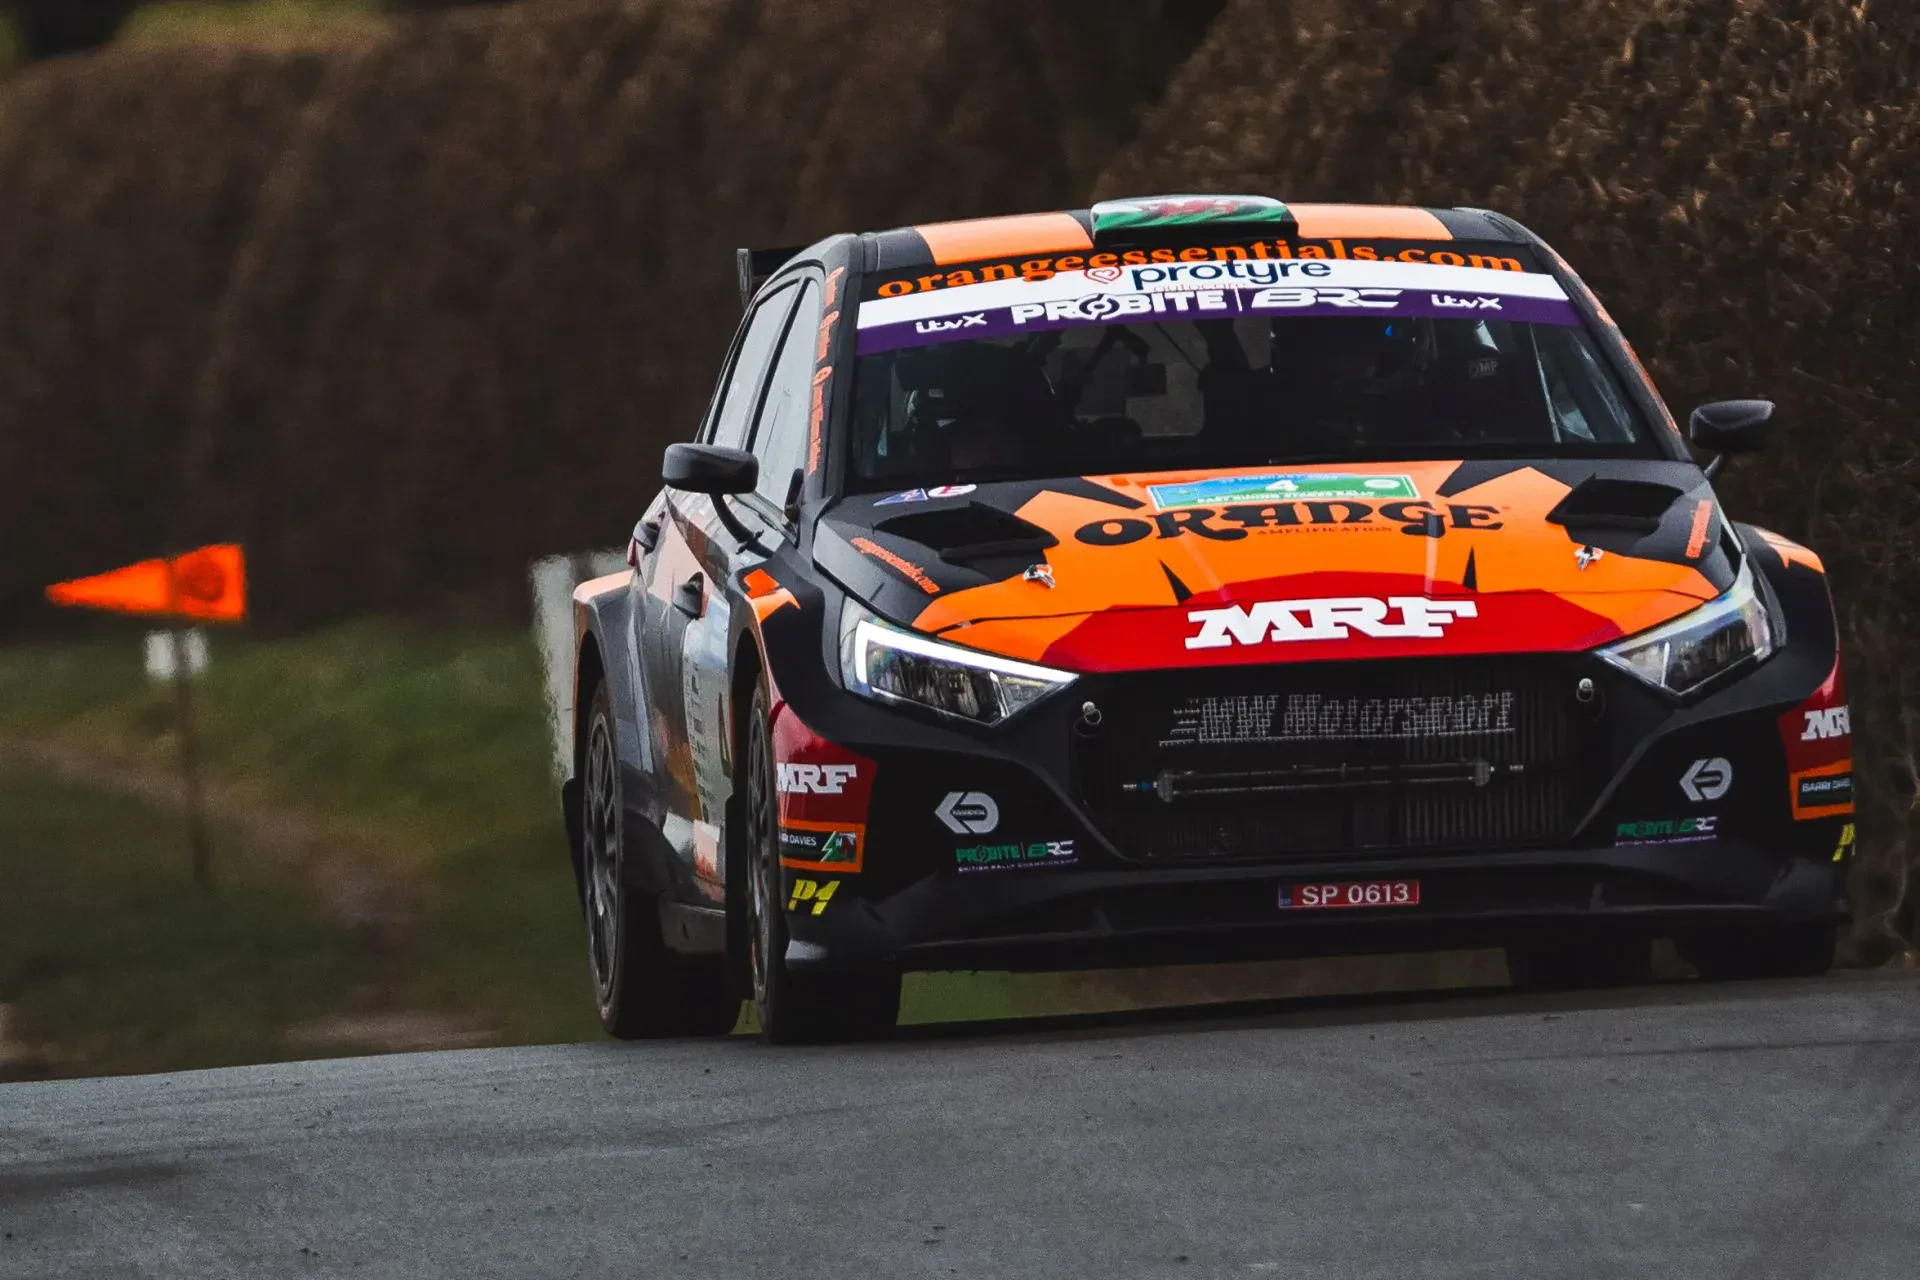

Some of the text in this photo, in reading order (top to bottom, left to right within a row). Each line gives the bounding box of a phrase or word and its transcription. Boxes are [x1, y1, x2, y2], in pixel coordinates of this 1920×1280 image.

[877, 239, 1524, 298] orangeessentials.com
[1131, 259, 1332, 291] protyre
[1010, 286, 1404, 325] PROBITE BRC
[1265, 479, 1299, 492] 4
[1074, 501, 1505, 546] ORANGE
[1184, 596, 1479, 650] MRF
[1801, 706, 1851, 740] MR
[777, 762, 857, 794] MRF
[790, 834, 818, 847] DAVIES
[788, 879, 840, 915] P1
[1302, 883, 1409, 905] SP 0613
